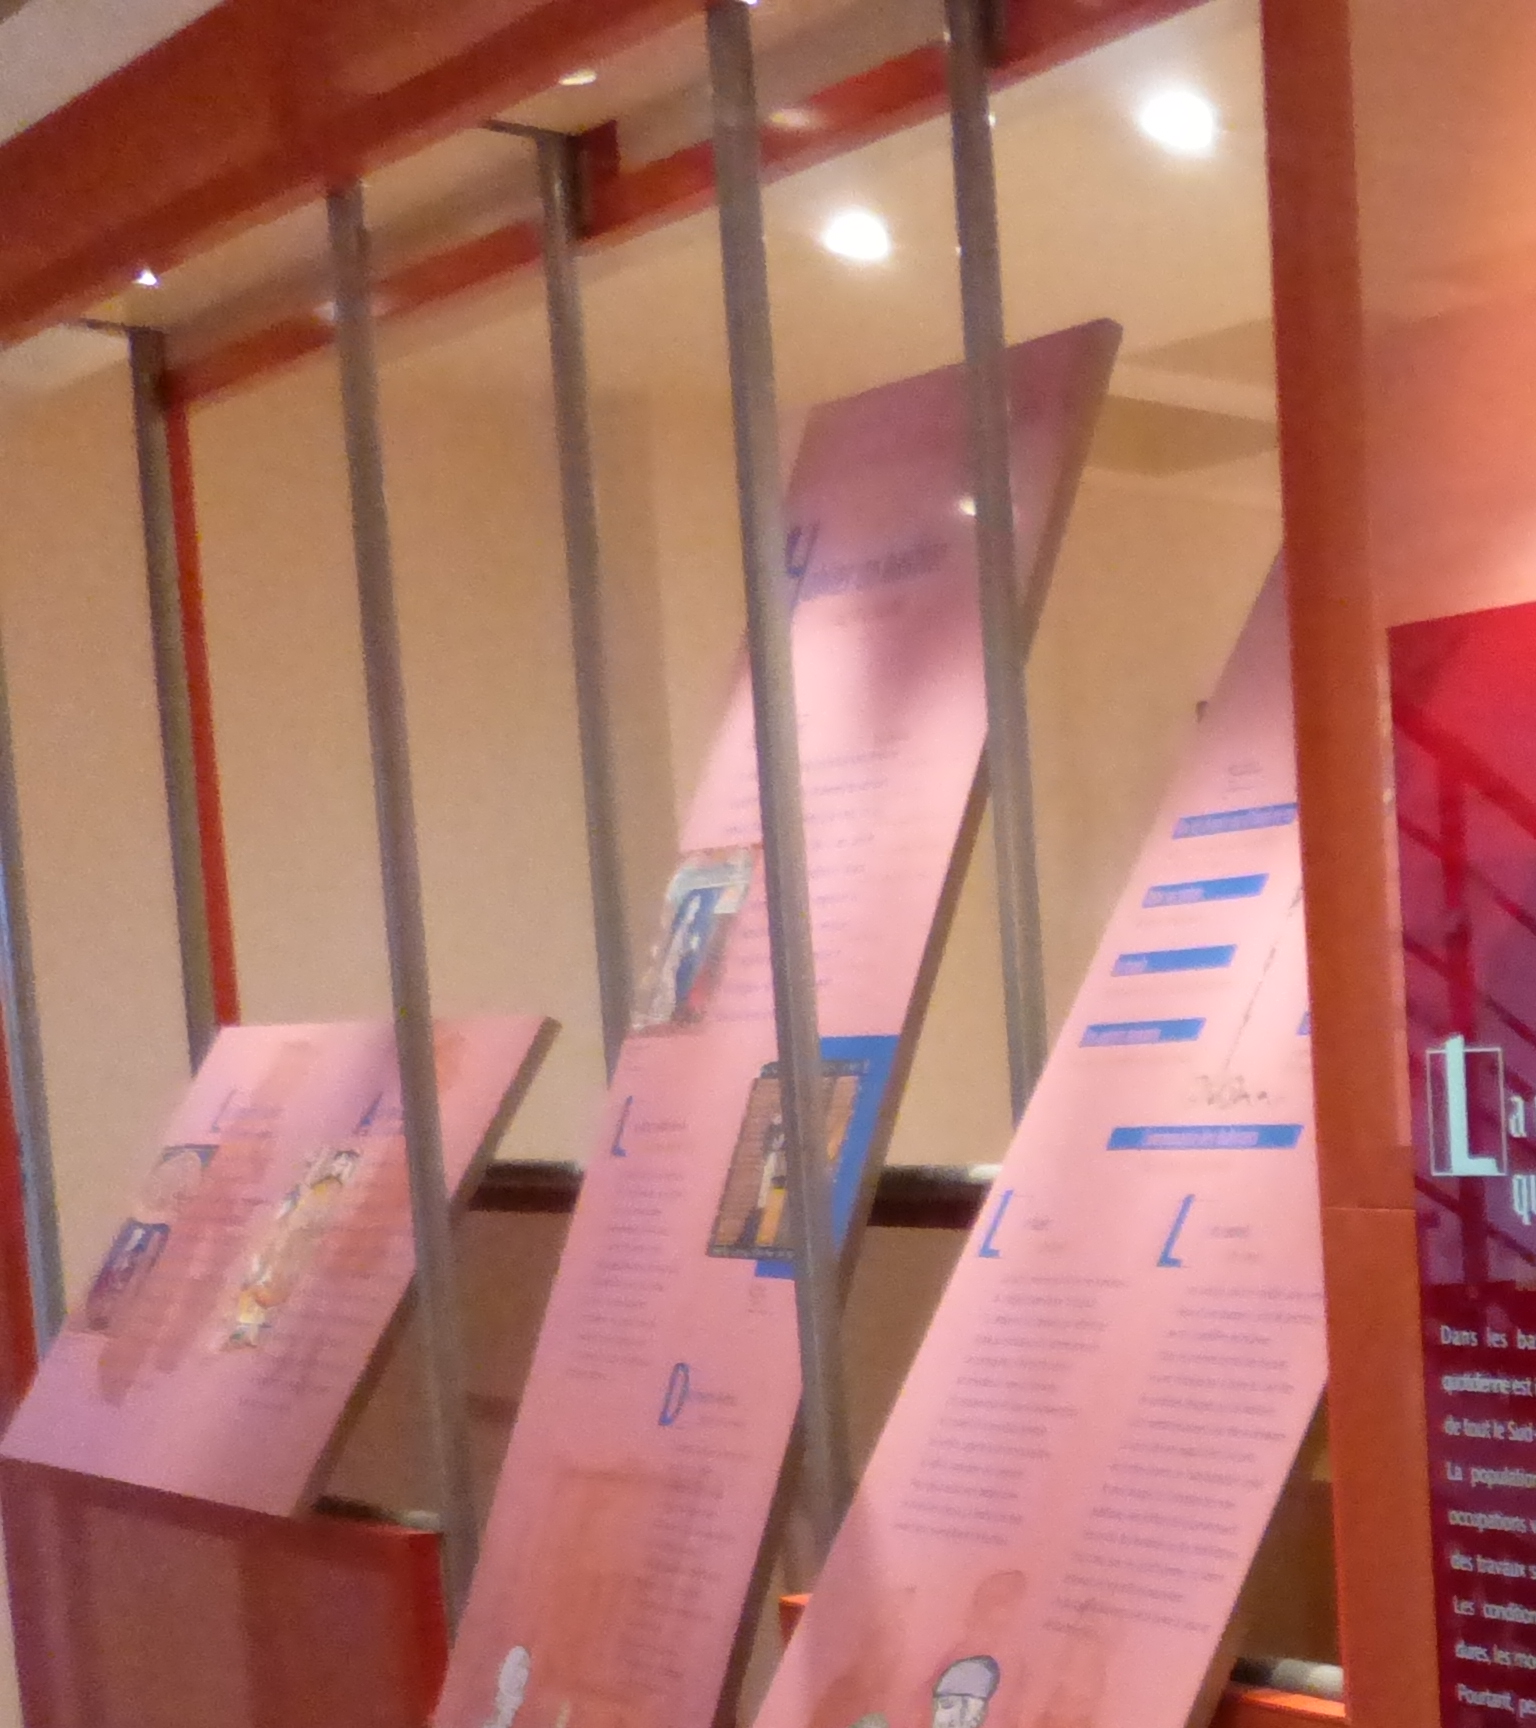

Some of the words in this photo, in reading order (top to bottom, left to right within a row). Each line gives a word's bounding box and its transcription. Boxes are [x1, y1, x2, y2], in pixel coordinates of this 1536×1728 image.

[1445, 1034, 1526, 1174] La
[1440, 1325, 1478, 1347] Dans
[1487, 1326, 1508, 1348] les
[1446, 1461, 1463, 1481] La
[1453, 1595, 1475, 1616] Les
